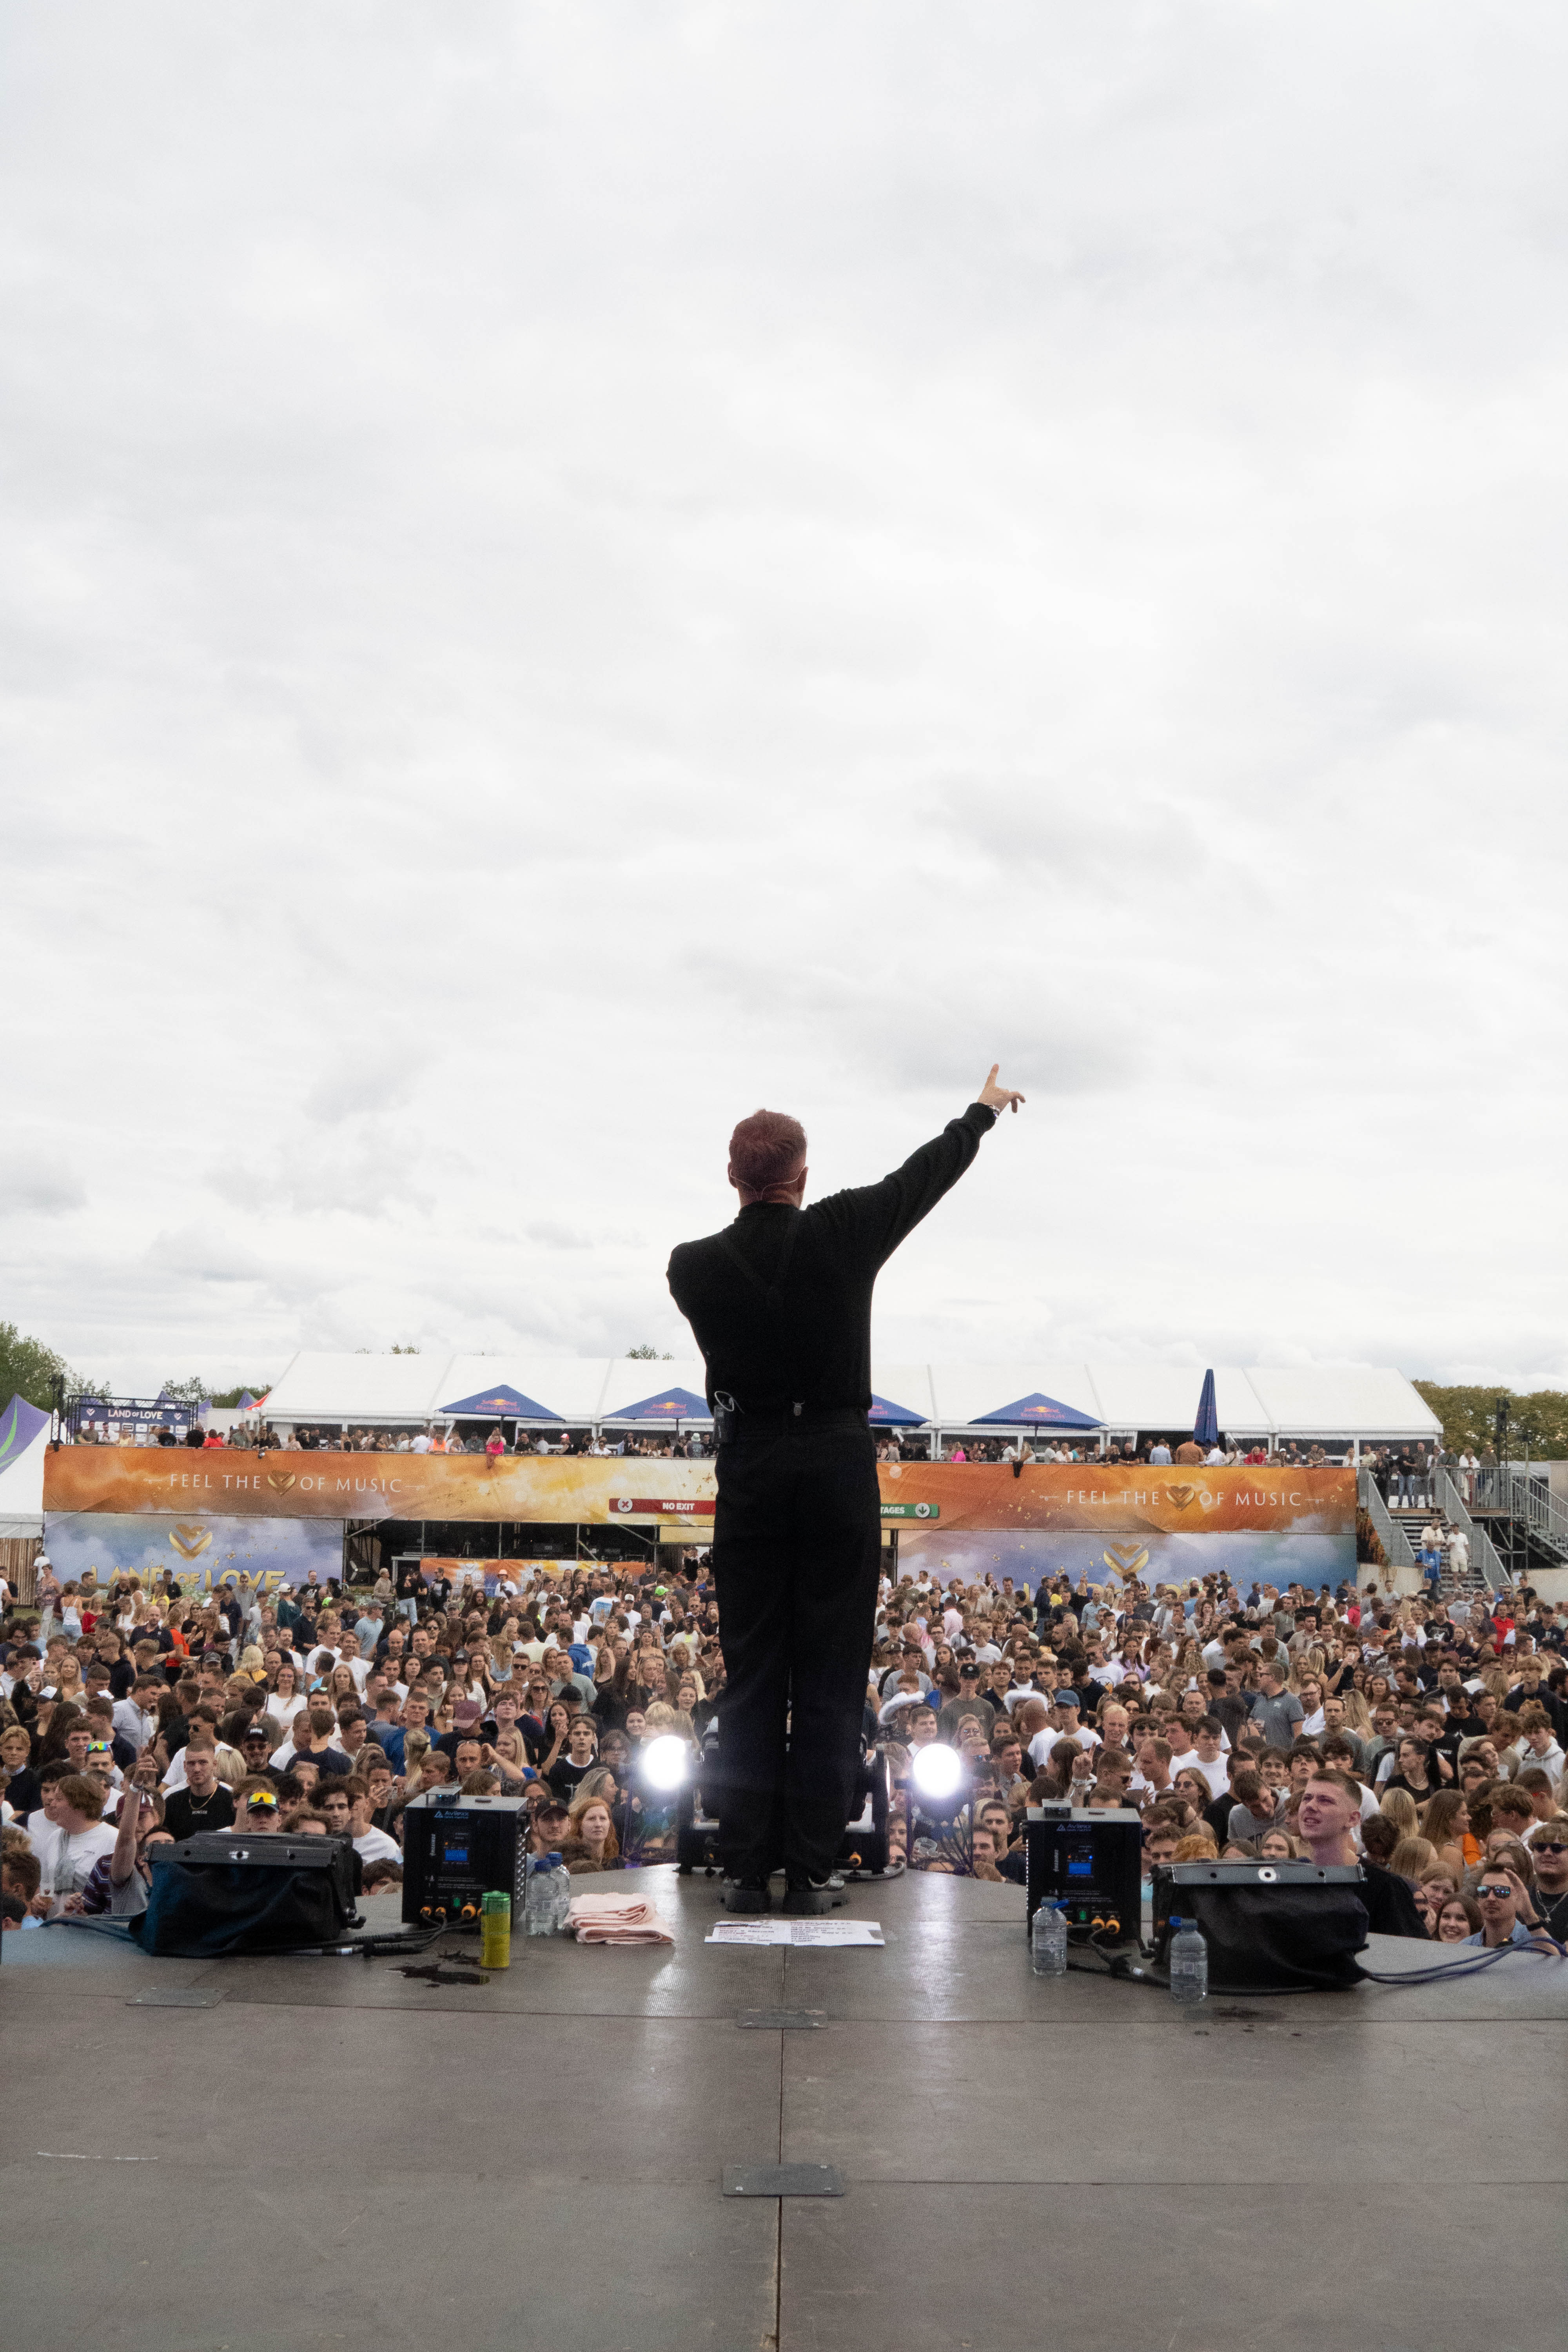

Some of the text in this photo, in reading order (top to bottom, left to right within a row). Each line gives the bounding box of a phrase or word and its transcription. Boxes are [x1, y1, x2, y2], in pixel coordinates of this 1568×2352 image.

[108, 1409, 132, 1418] LAND
[140, 1411, 163, 1419] LOVE
[170, 1474, 402, 1492] FEEL THE OF MUSIC
[1067, 1490, 1301, 1506] FEEL THE OF MUSIC
[174, 1572, 201, 1584] OF
[205, 1569, 286, 1592] LOVE
